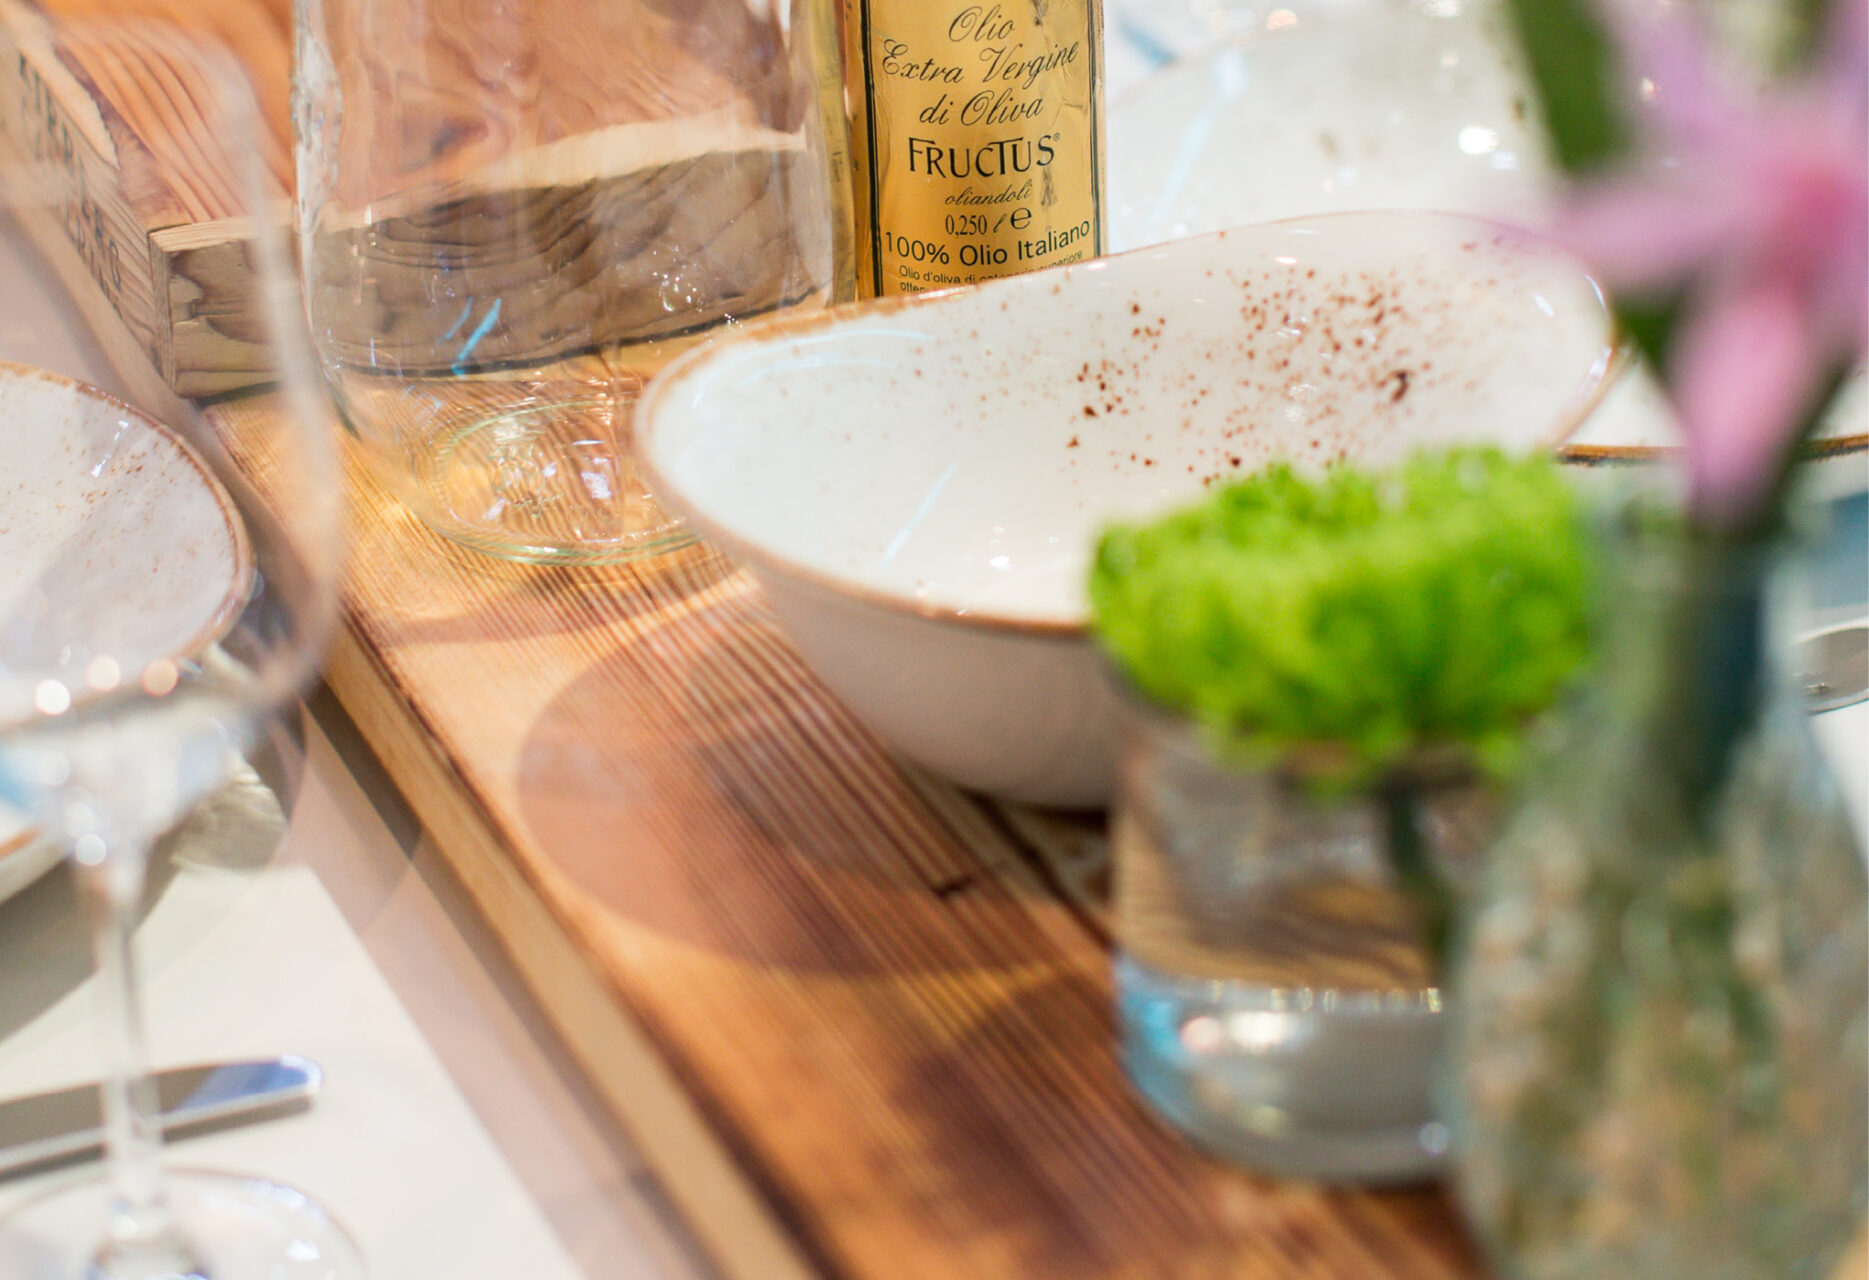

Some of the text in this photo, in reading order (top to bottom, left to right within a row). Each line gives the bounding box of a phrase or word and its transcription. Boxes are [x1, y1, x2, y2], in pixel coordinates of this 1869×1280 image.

[948, 4, 1015, 42] Olio
[882, 38, 1080, 90] Extra Vergine
[919, 87, 1045, 127] di Oliva
[944, 178, 1033, 206] oliandoli
[886, 220, 1090, 267] 100% Olio Italiano
[945, 214, 988, 238] 0,250
[899, 265, 920, 280] Olio
[923, 271, 961, 284] d'oliva
